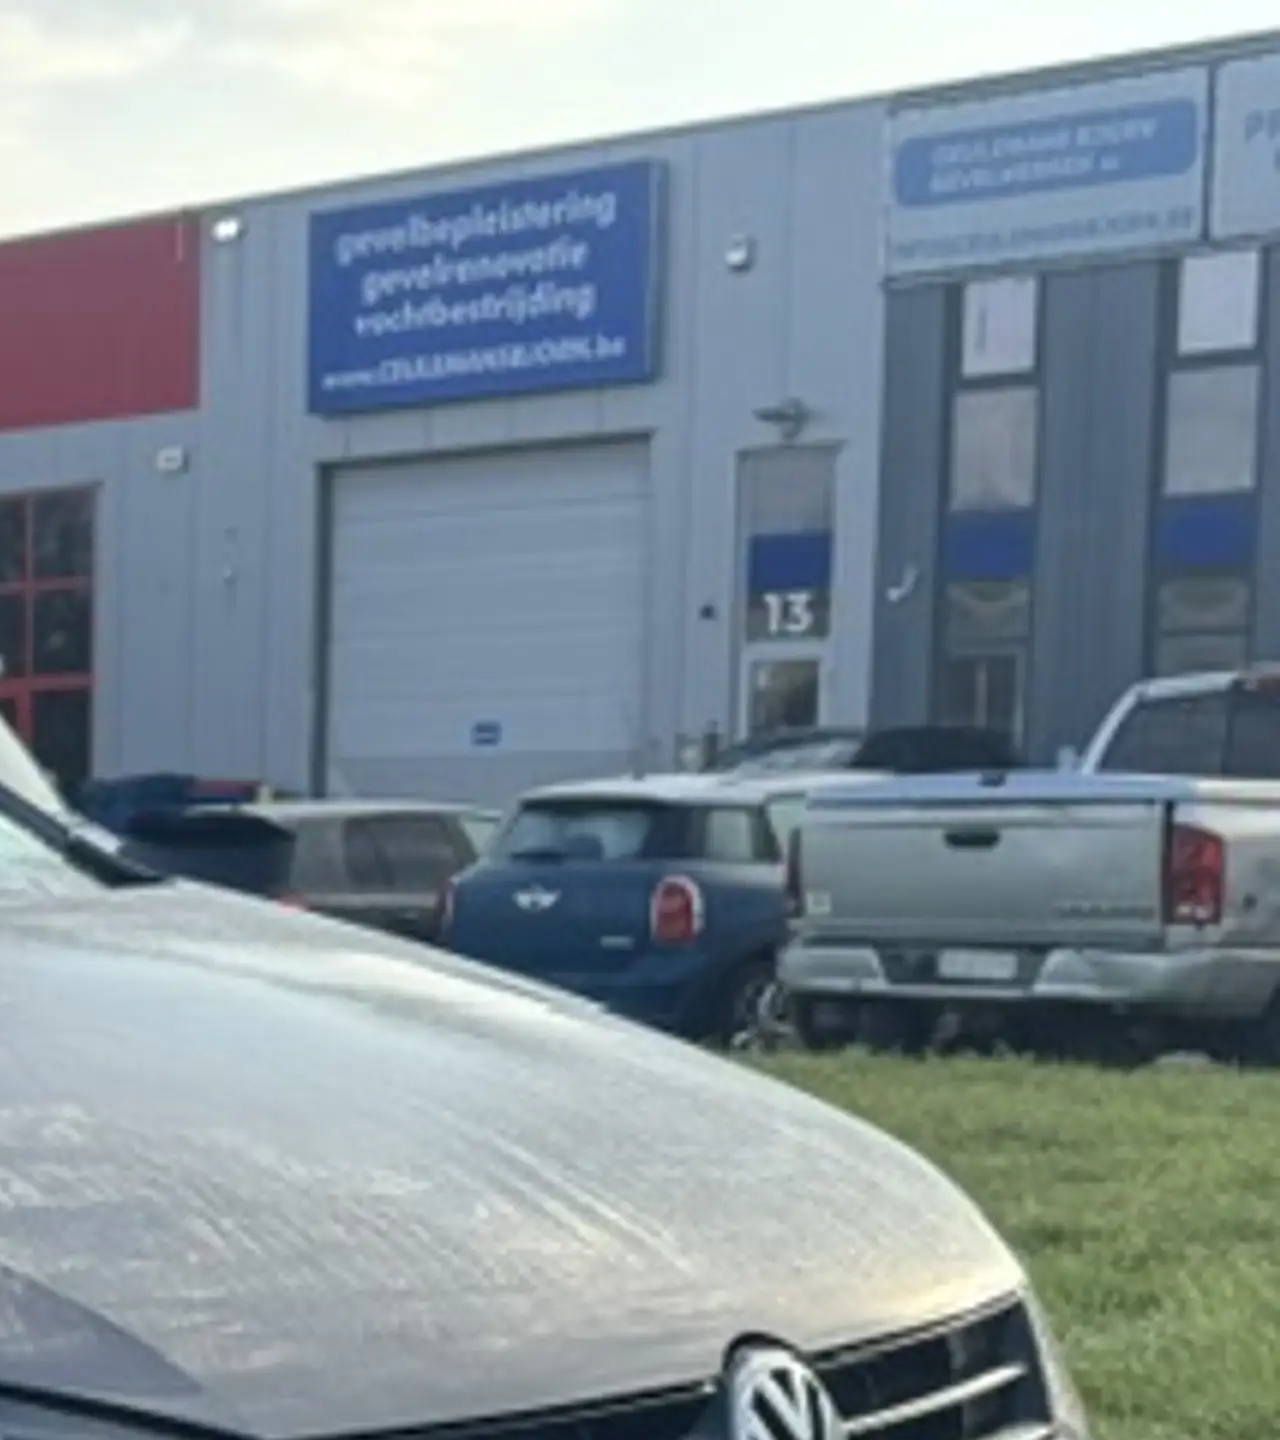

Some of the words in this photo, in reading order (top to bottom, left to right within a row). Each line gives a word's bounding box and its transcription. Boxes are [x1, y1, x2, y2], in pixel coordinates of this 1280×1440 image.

[333, 190, 617, 267] gevelbepleistering
[360, 233, 590, 307] gevelrenovatie
[352, 281, 599, 338] vochtbestrijding
[762, 590, 815, 635] 13
